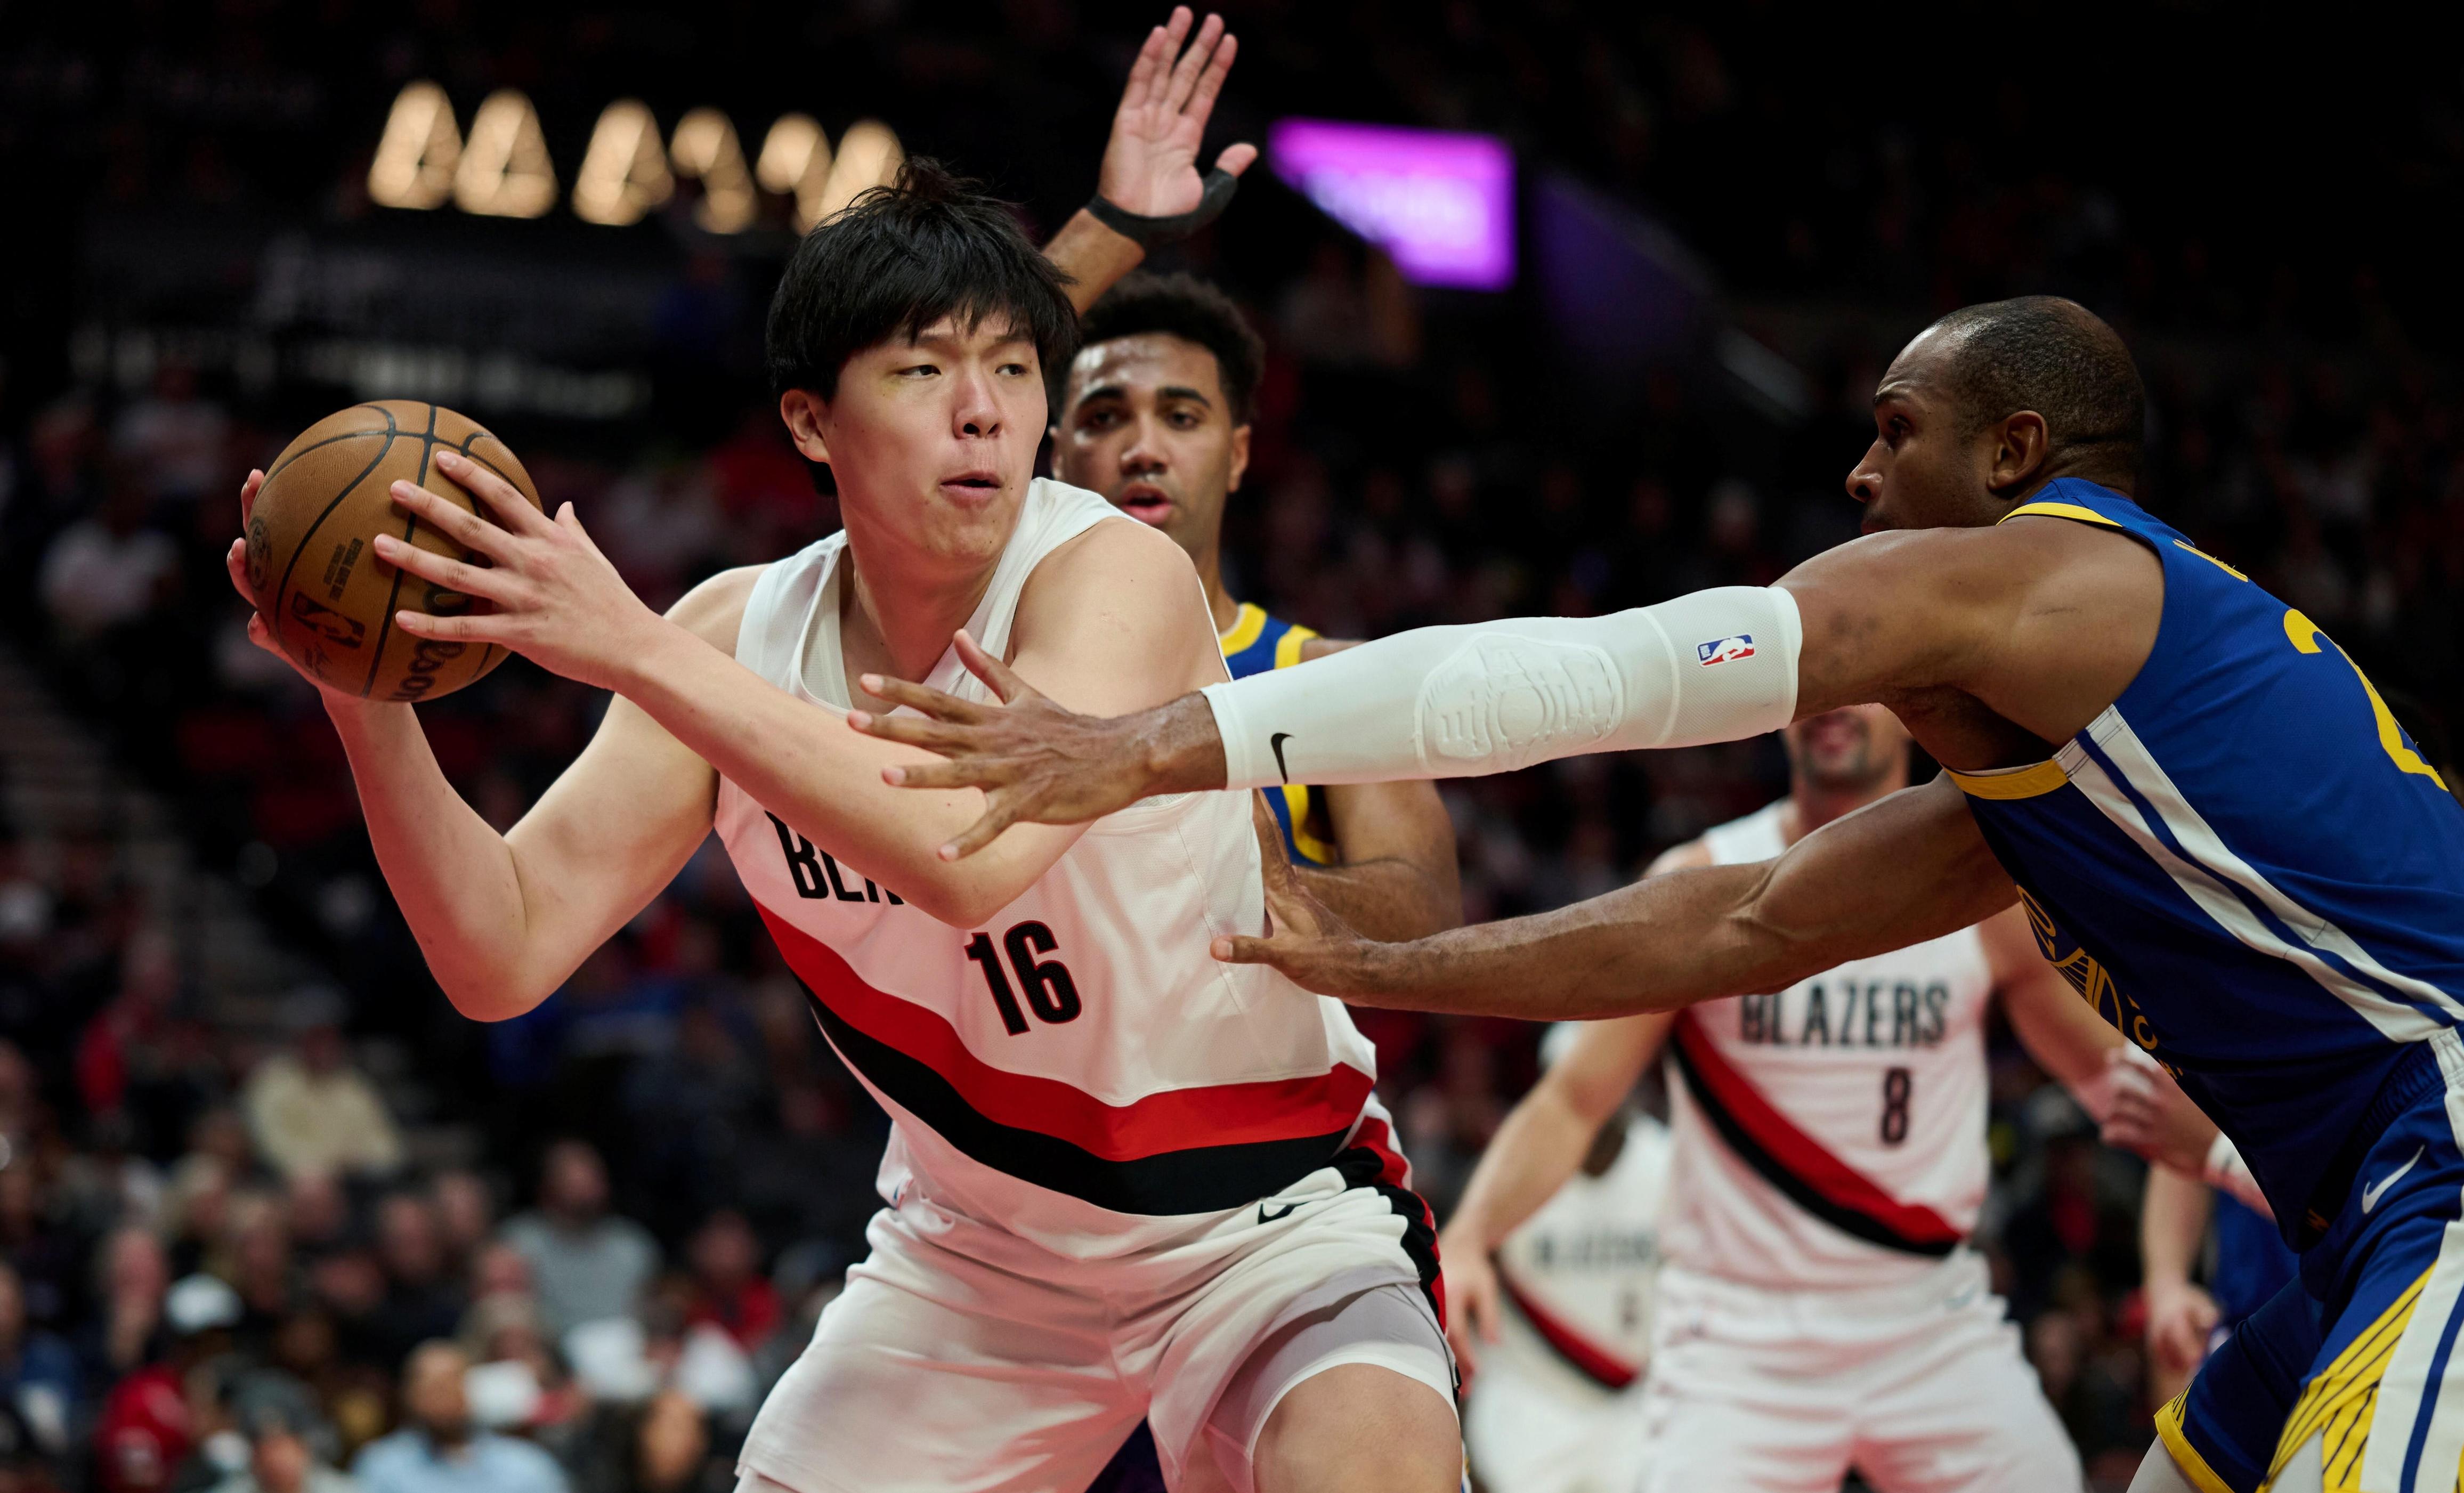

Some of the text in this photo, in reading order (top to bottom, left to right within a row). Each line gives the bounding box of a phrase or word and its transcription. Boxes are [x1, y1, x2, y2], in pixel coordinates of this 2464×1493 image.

[964, 920, 1082, 1036] 16
[1742, 981, 1948, 1045] BLAZERS
[1881, 1067, 1911, 1146] 8
